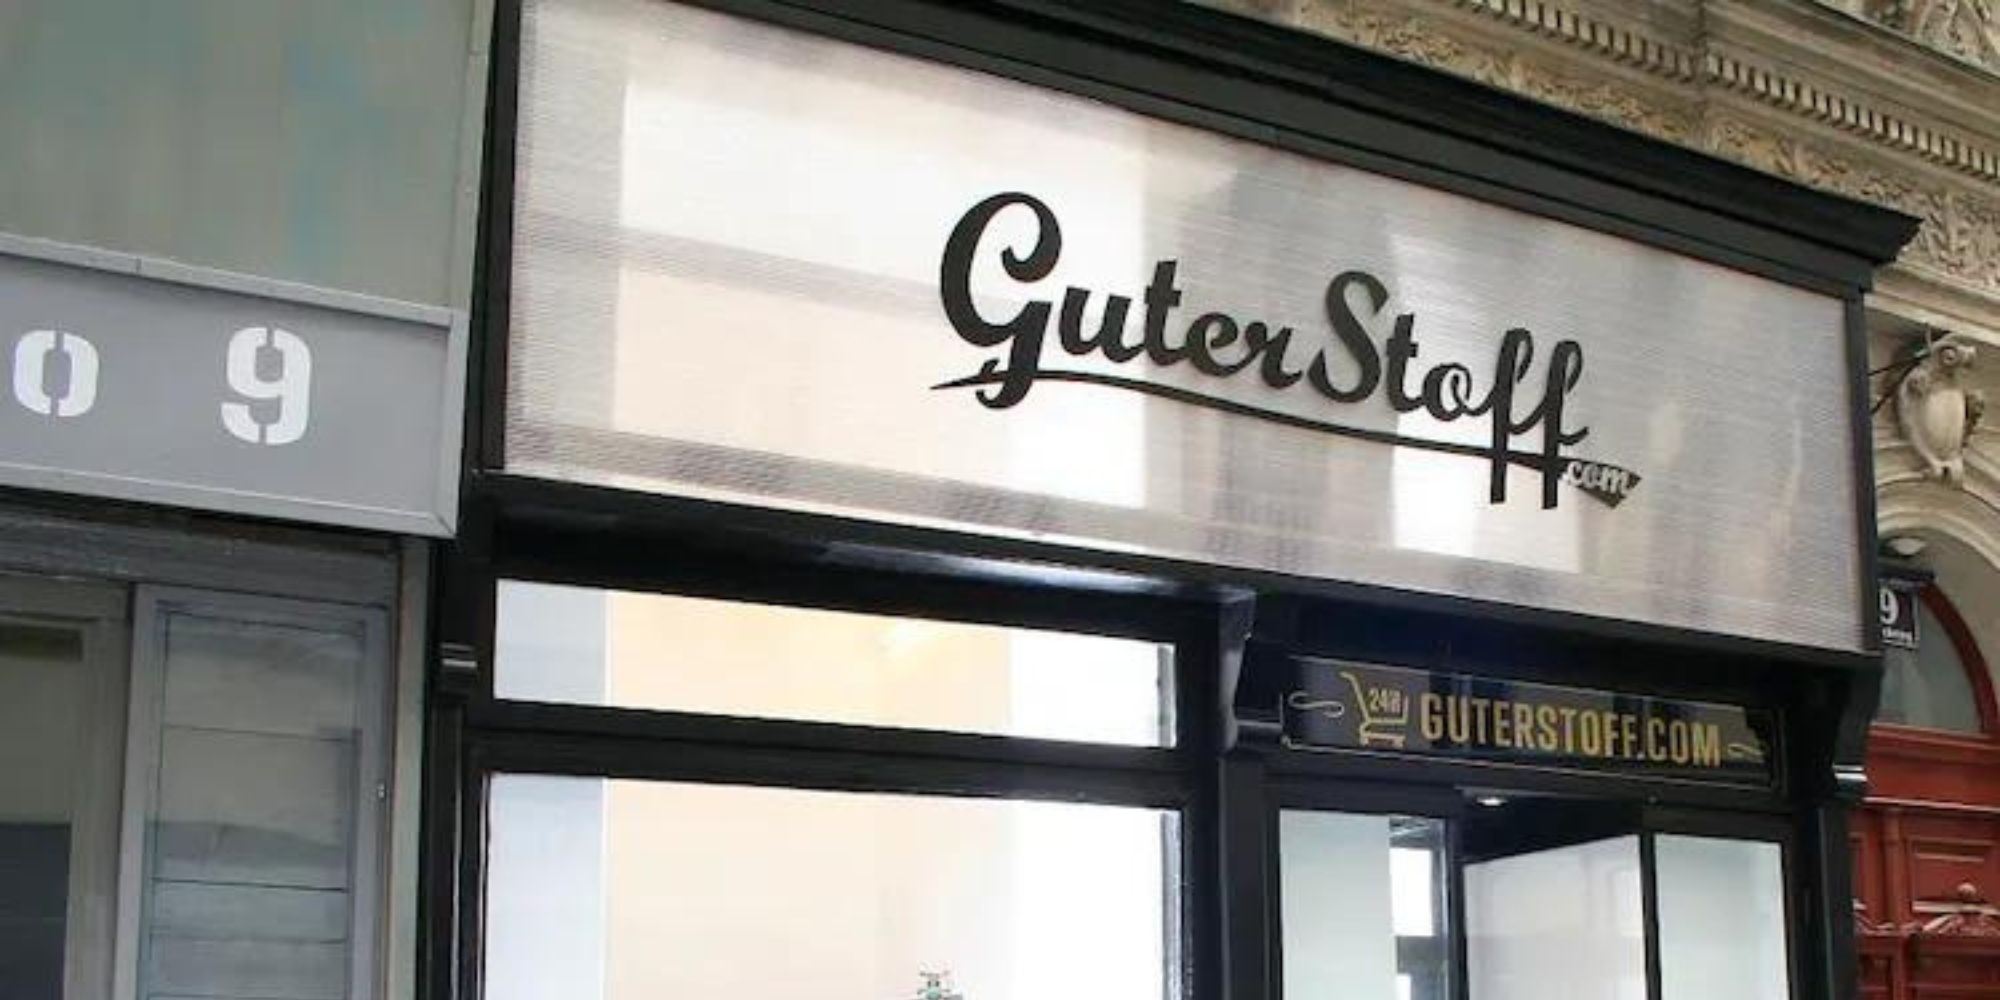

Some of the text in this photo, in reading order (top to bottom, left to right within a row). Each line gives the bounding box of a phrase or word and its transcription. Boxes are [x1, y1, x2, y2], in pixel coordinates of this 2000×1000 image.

[220, 326, 312, 446] 9
[940, 191, 1590, 509] Guter Stoff
[1420, 692, 1722, 767] GUTERSTOFF.COM
